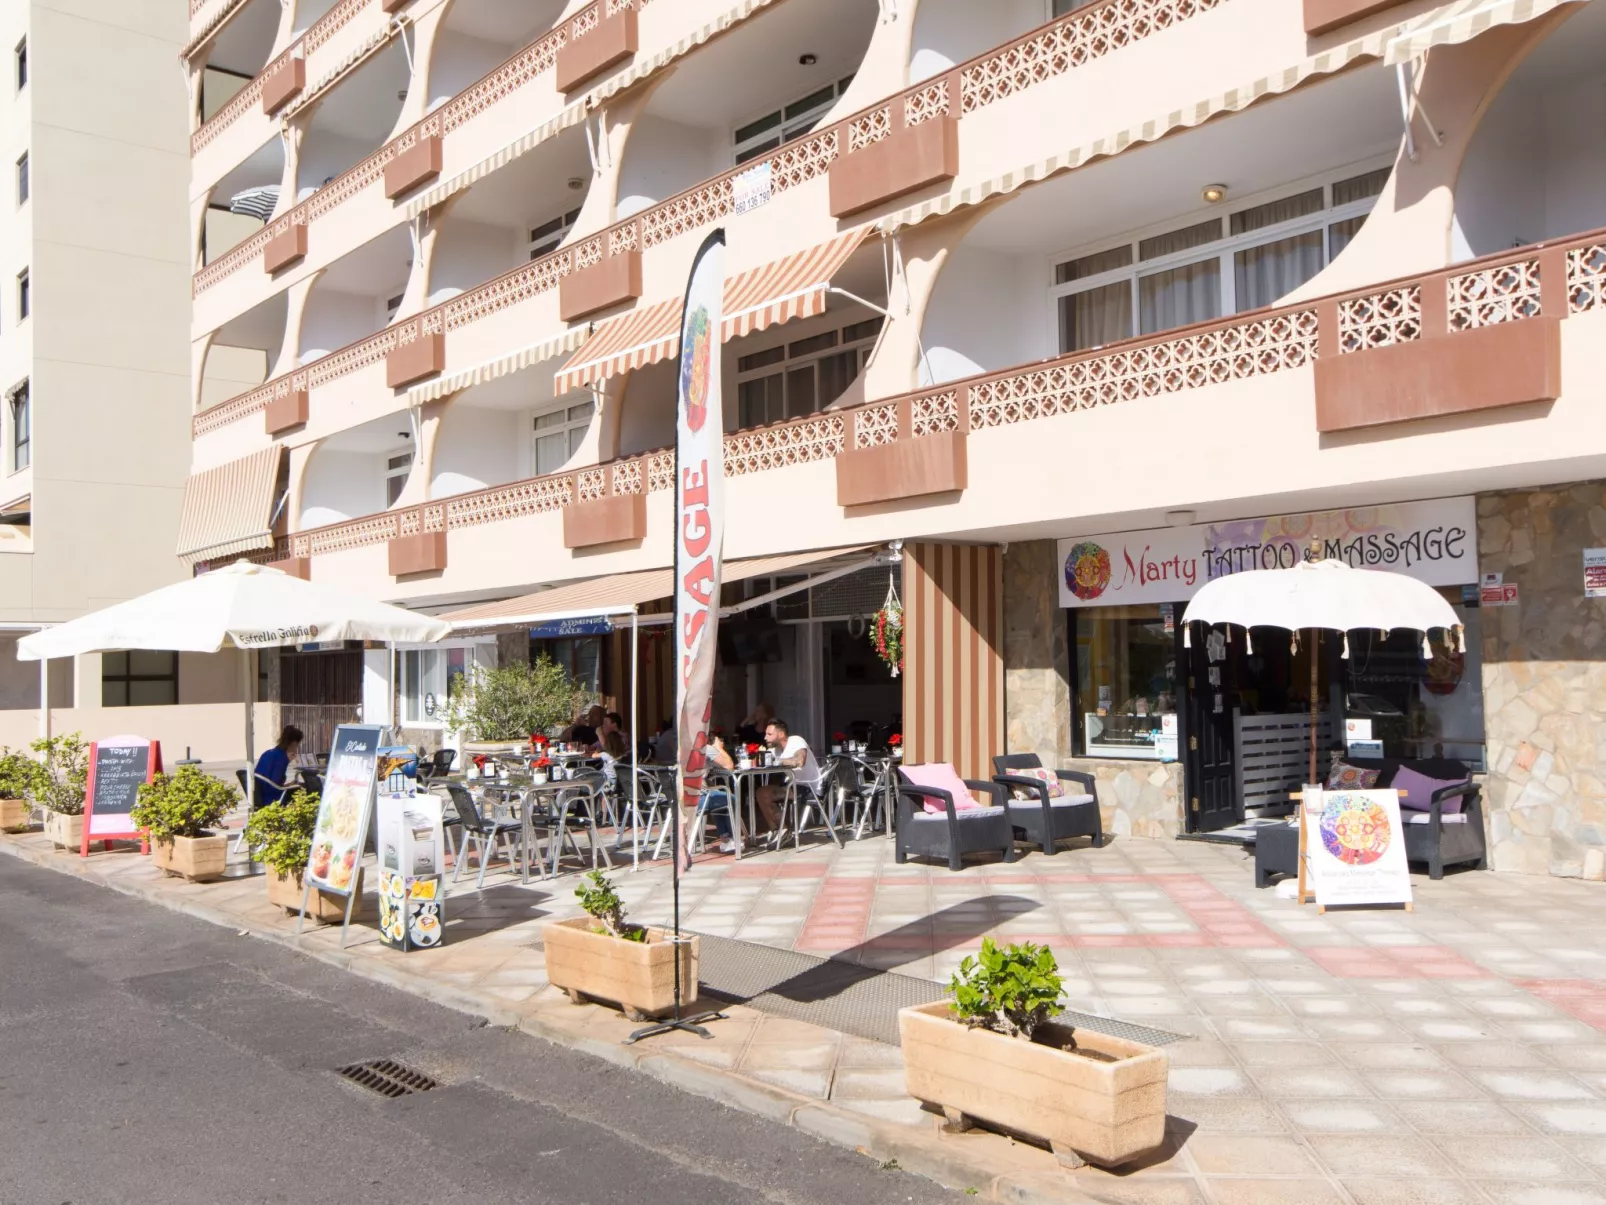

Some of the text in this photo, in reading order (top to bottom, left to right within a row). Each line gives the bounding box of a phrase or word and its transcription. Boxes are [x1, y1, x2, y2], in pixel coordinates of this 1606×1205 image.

[751, 183, 769, 194] SALE
[1112, 541, 1197, 590] Marty
[1202, 541, 1296, 577] TATTOO
[1324, 526, 1466, 568] MASSAGE
[240, 626, 310, 644] Estrella Galicia
[558, 627, 582, 635] SALE
[109, 748, 132, 756] TODAY
